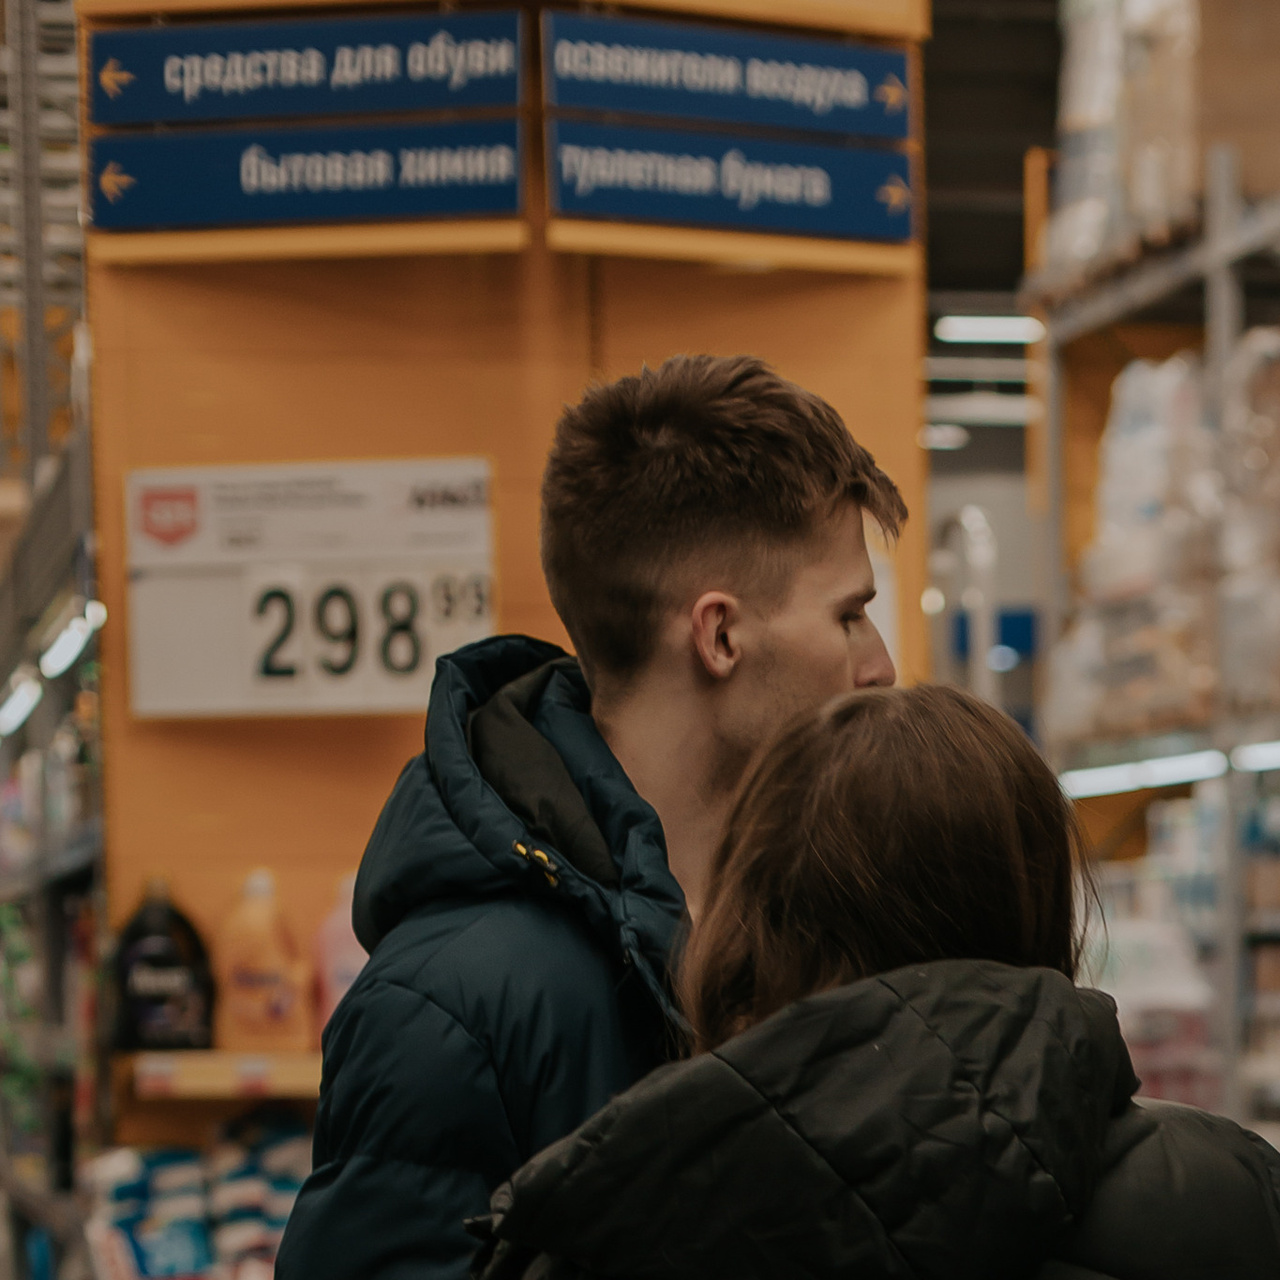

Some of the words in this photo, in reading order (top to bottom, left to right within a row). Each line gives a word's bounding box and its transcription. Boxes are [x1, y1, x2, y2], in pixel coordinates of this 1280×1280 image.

[163, 48, 326, 104] средства
[330, 44, 401, 91] для
[406, 30, 516, 91] обуви
[555, 39, 743, 94] освежители
[746, 57, 869, 115] воздуха
[239, 143, 394, 196] бытовая
[399, 144, 516, 189] химия
[558, 144, 718, 197] туалетная
[720, 148, 832, 211] бумага
[254, 582, 423, 679] 298
